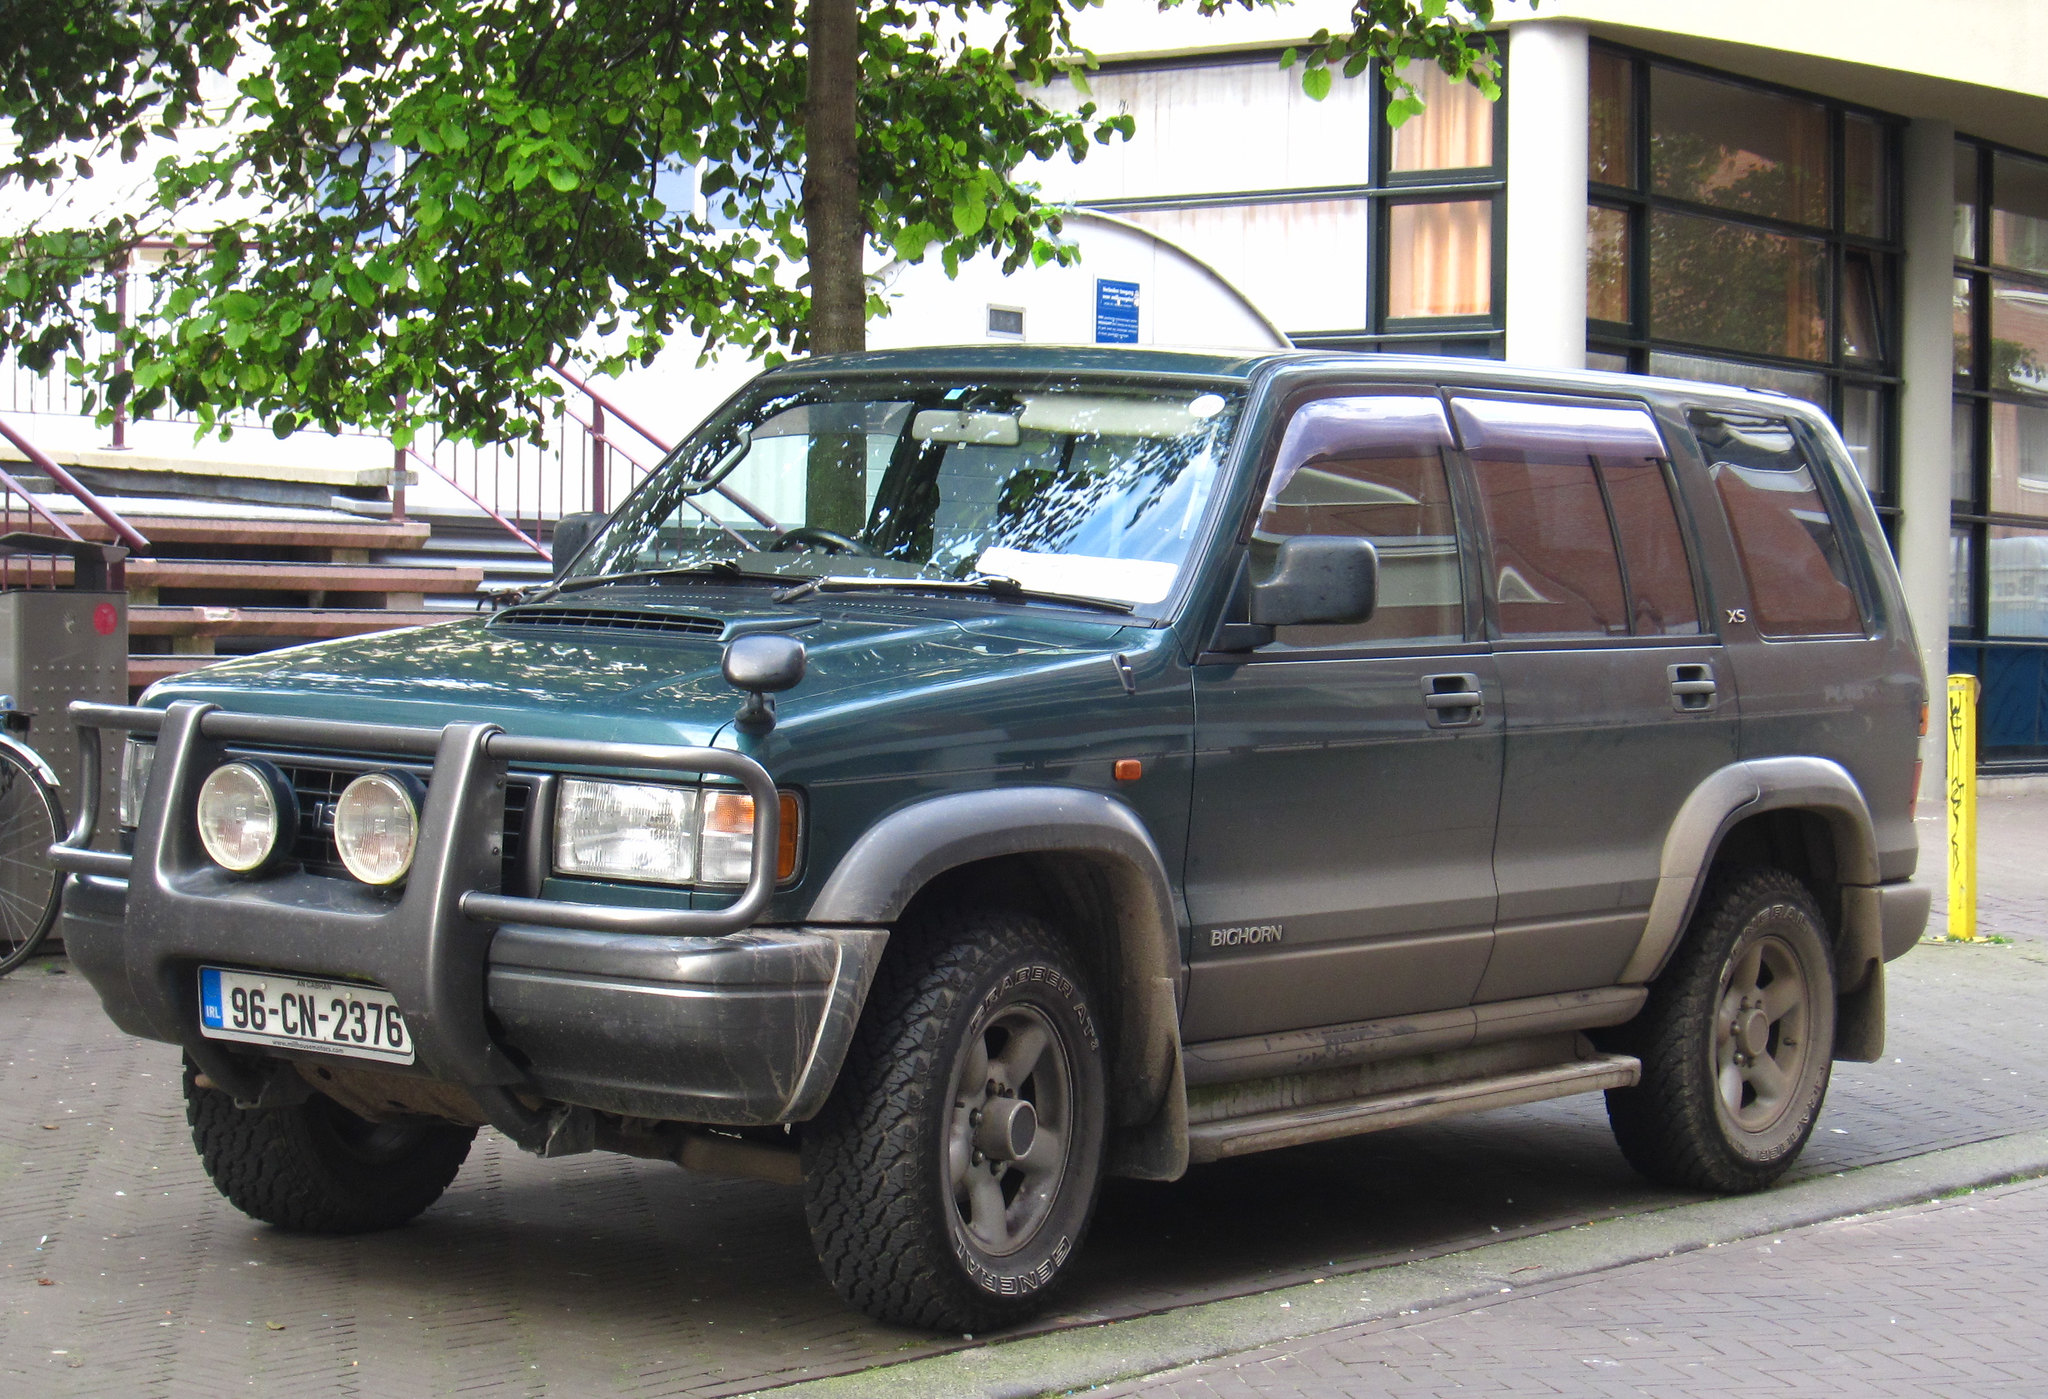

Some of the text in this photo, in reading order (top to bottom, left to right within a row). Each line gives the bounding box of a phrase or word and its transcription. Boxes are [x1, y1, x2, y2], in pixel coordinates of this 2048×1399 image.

[1725, 608, 1747, 624] XS
[1211, 924, 1283, 947] BIGHORN
[205, 1005, 221, 1019] IRL
[231, 986, 404, 1048] 96-CN-2376
[955, 1226, 1073, 1295] GENERAL
